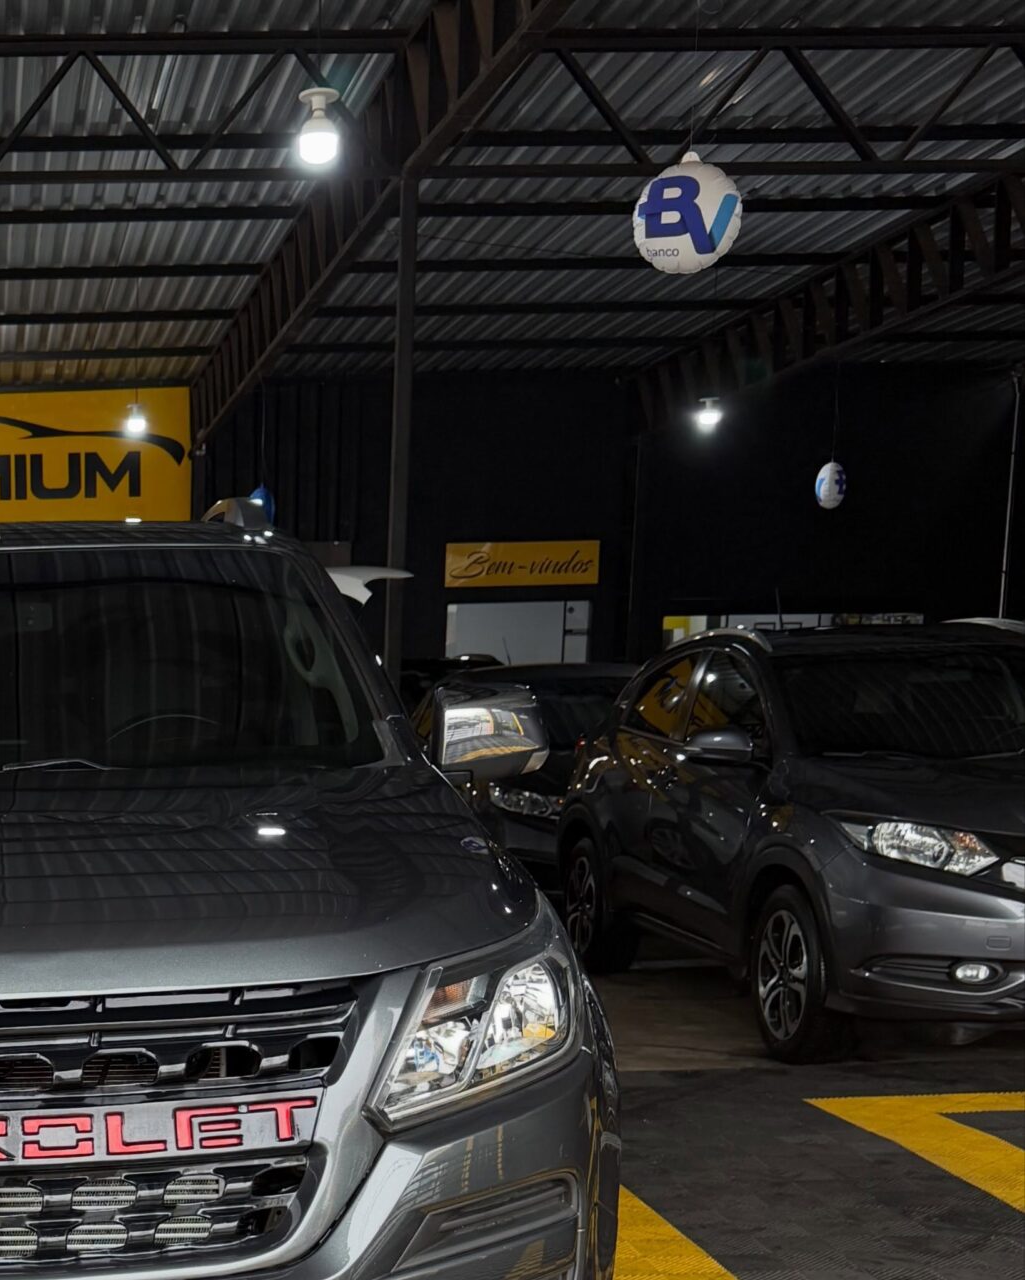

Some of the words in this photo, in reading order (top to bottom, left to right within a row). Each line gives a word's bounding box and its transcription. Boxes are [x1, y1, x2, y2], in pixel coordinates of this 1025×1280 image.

[638, 175, 739, 255] BV
[645, 246, 680, 259] banco
[449, 549, 594, 579] Bem-vindos
